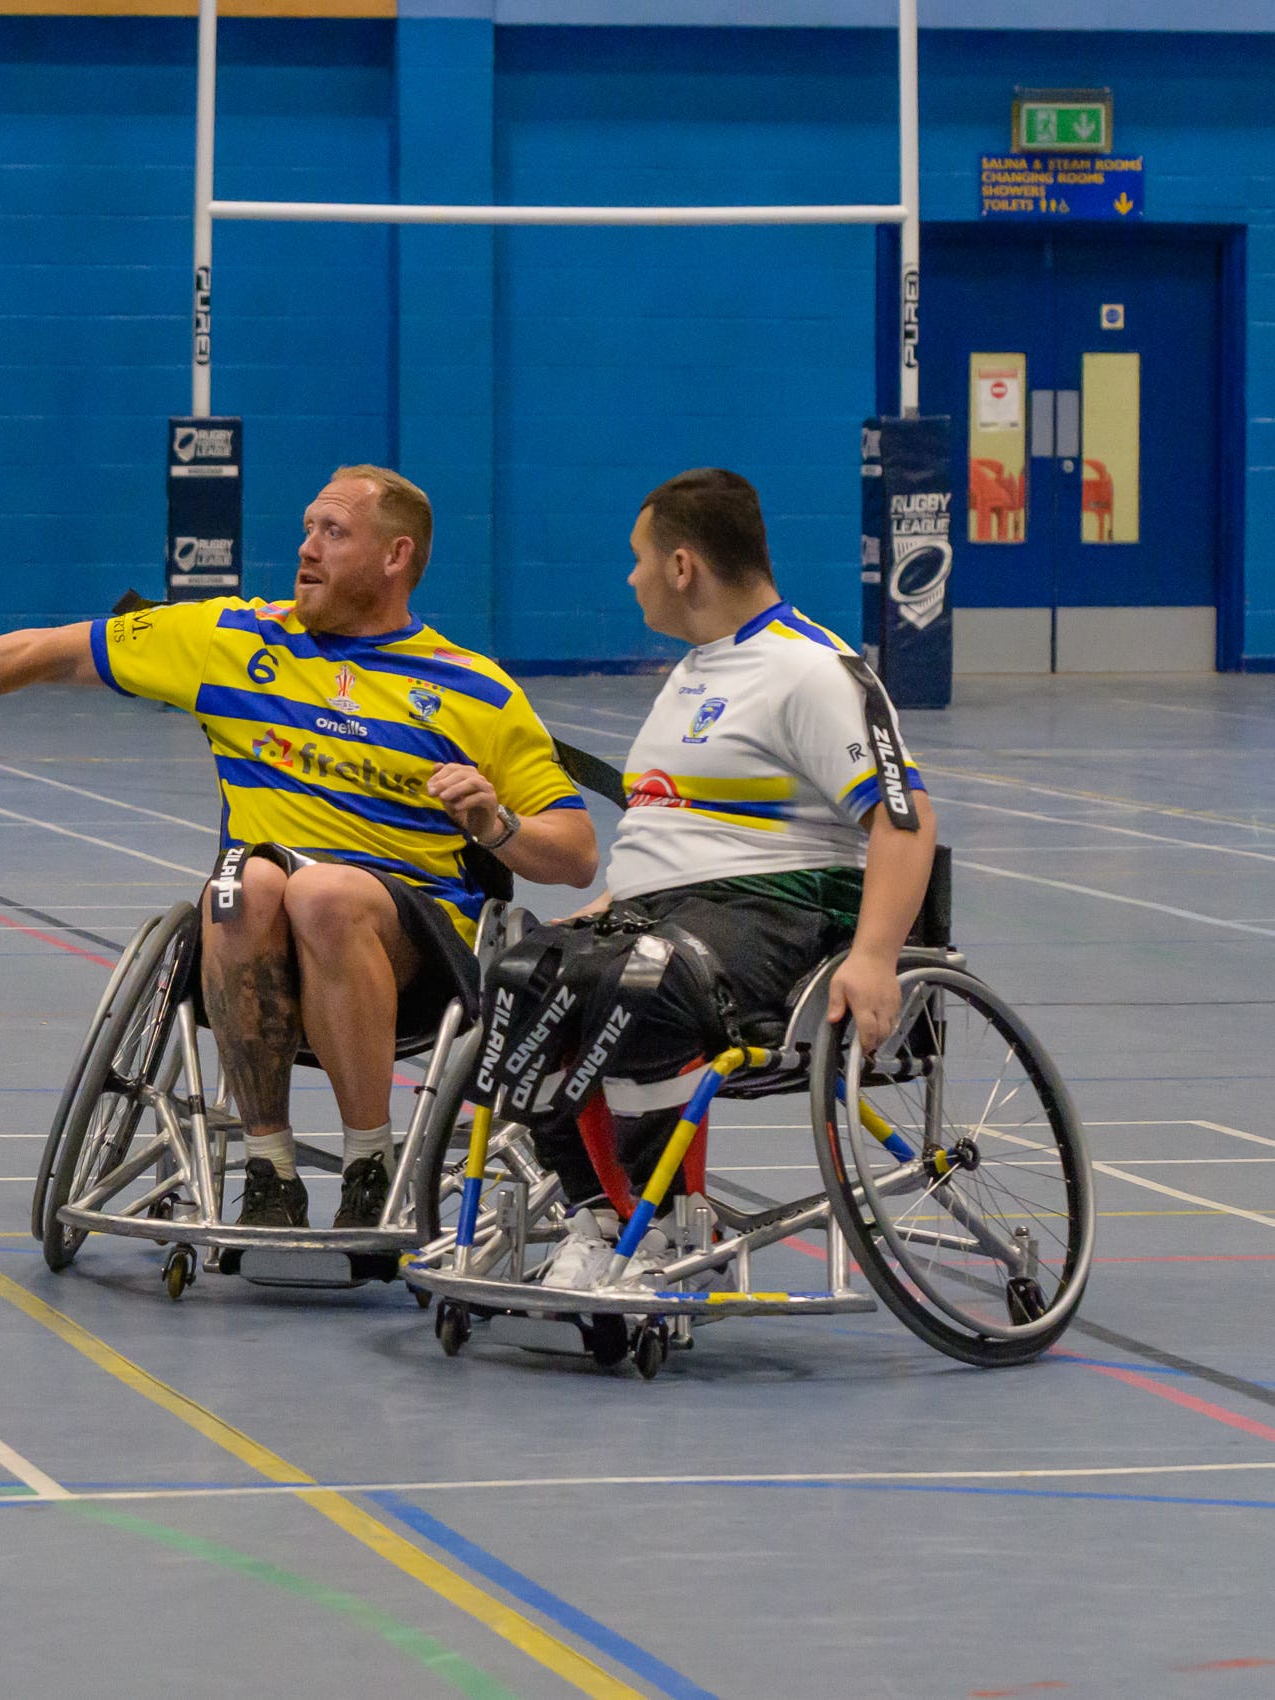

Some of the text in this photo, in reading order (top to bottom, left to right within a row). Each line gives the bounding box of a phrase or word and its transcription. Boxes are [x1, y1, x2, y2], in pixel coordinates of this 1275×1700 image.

[982, 157, 1027, 169] SAUNA
[1033, 159, 1042, 170] &
[1095, 159, 1142, 171] ROOMS
[982, 172, 1104, 184] CHANGING ROOMS
[982, 185, 1046, 197] SHOWERS
[984, 199, 1033, 211] TOILETS
[195, 266, 211, 365] PURE
[903, 271, 920, 367] PURE
[891, 493, 951, 512] RUGBY
[893, 519, 950, 534] LEAGUE
[247, 648, 279, 684] 6
[872, 725, 909, 815] ZILAND
[477, 987, 515, 1093] ZILAND
[505, 985, 577, 1075] ZILAND
[565, 1004, 632, 1101] ZILAND
